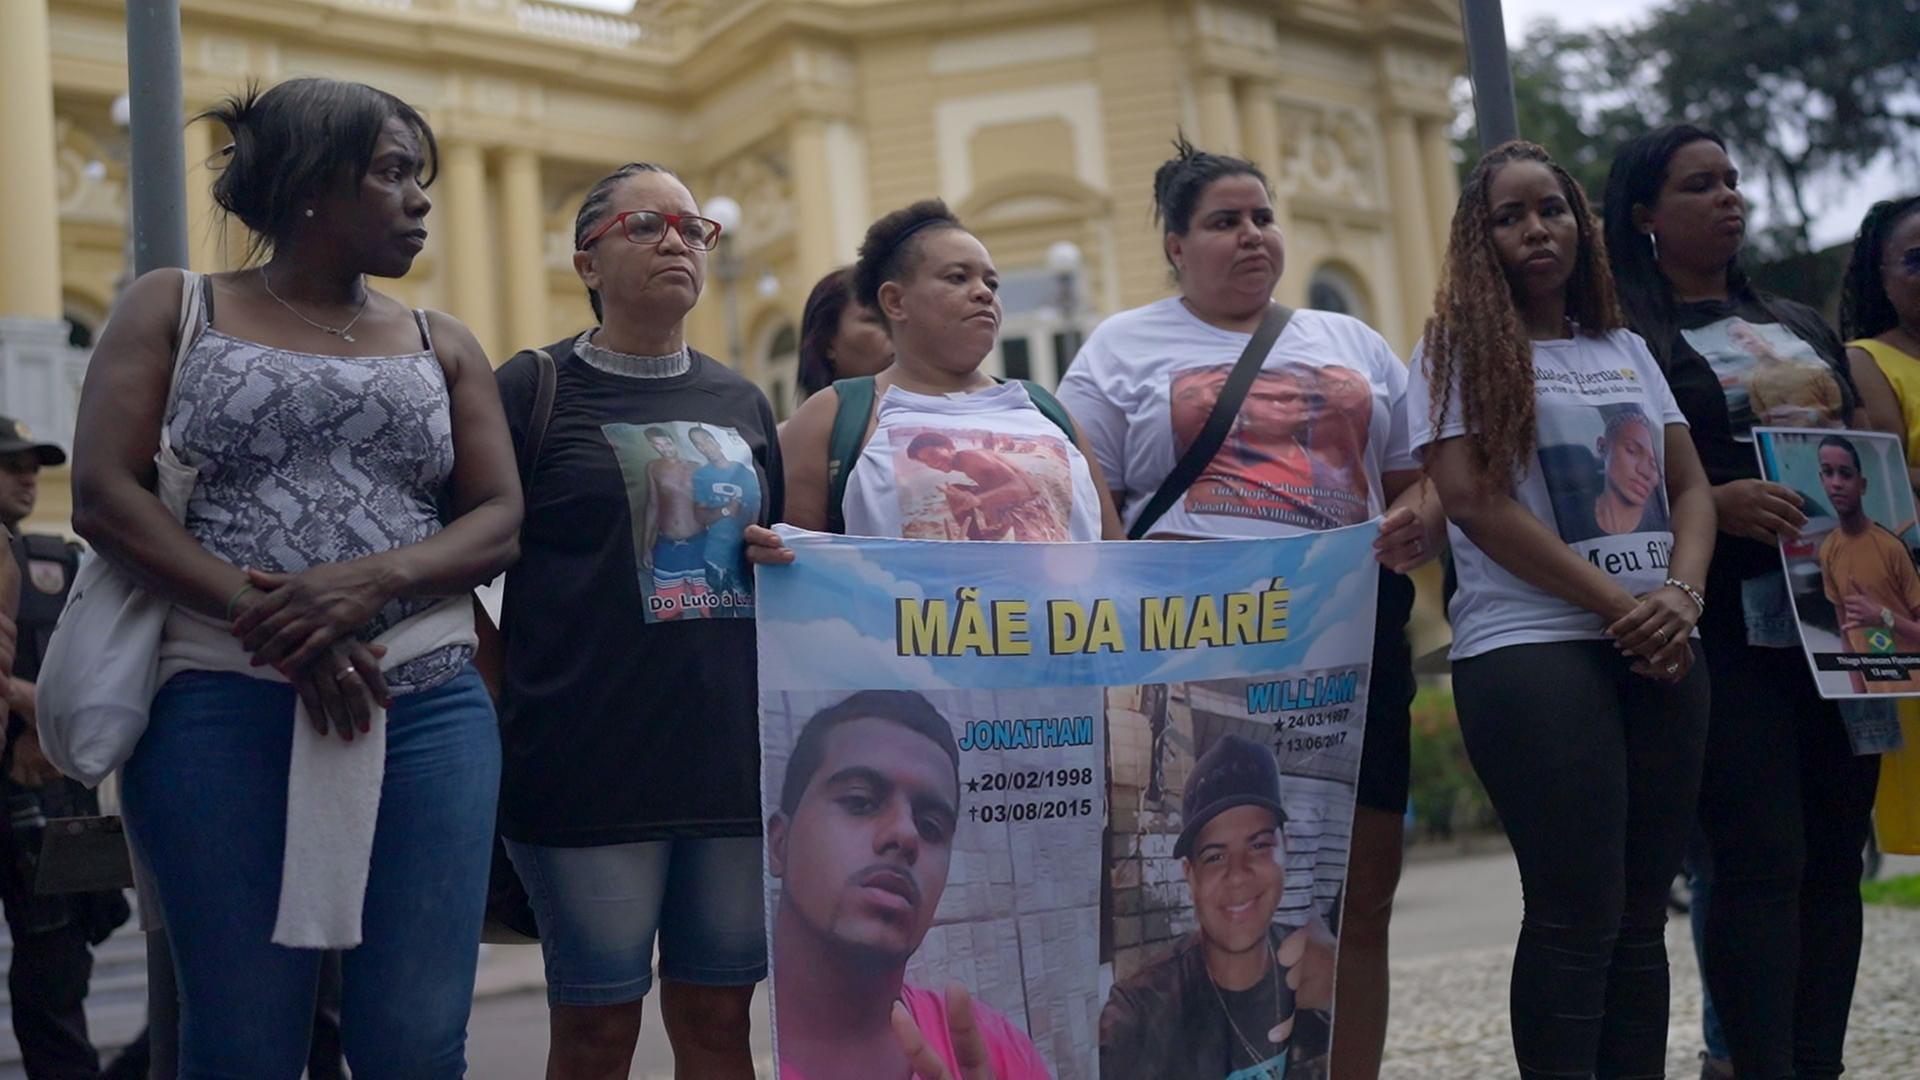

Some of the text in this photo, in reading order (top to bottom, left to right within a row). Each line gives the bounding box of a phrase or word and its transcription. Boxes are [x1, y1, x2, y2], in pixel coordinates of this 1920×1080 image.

[649, 596, 675, 612] Do
[680, 592, 719, 609] Luto
[897, 576, 1292, 656] MÃE DA MARÉ
[1247, 671, 1358, 714] WILLIAM
[959, 716, 1093, 750] JONATHAM
[981, 768, 1093, 791] 20/02/1998
[980, 799, 1092, 823] 03/08/2015
